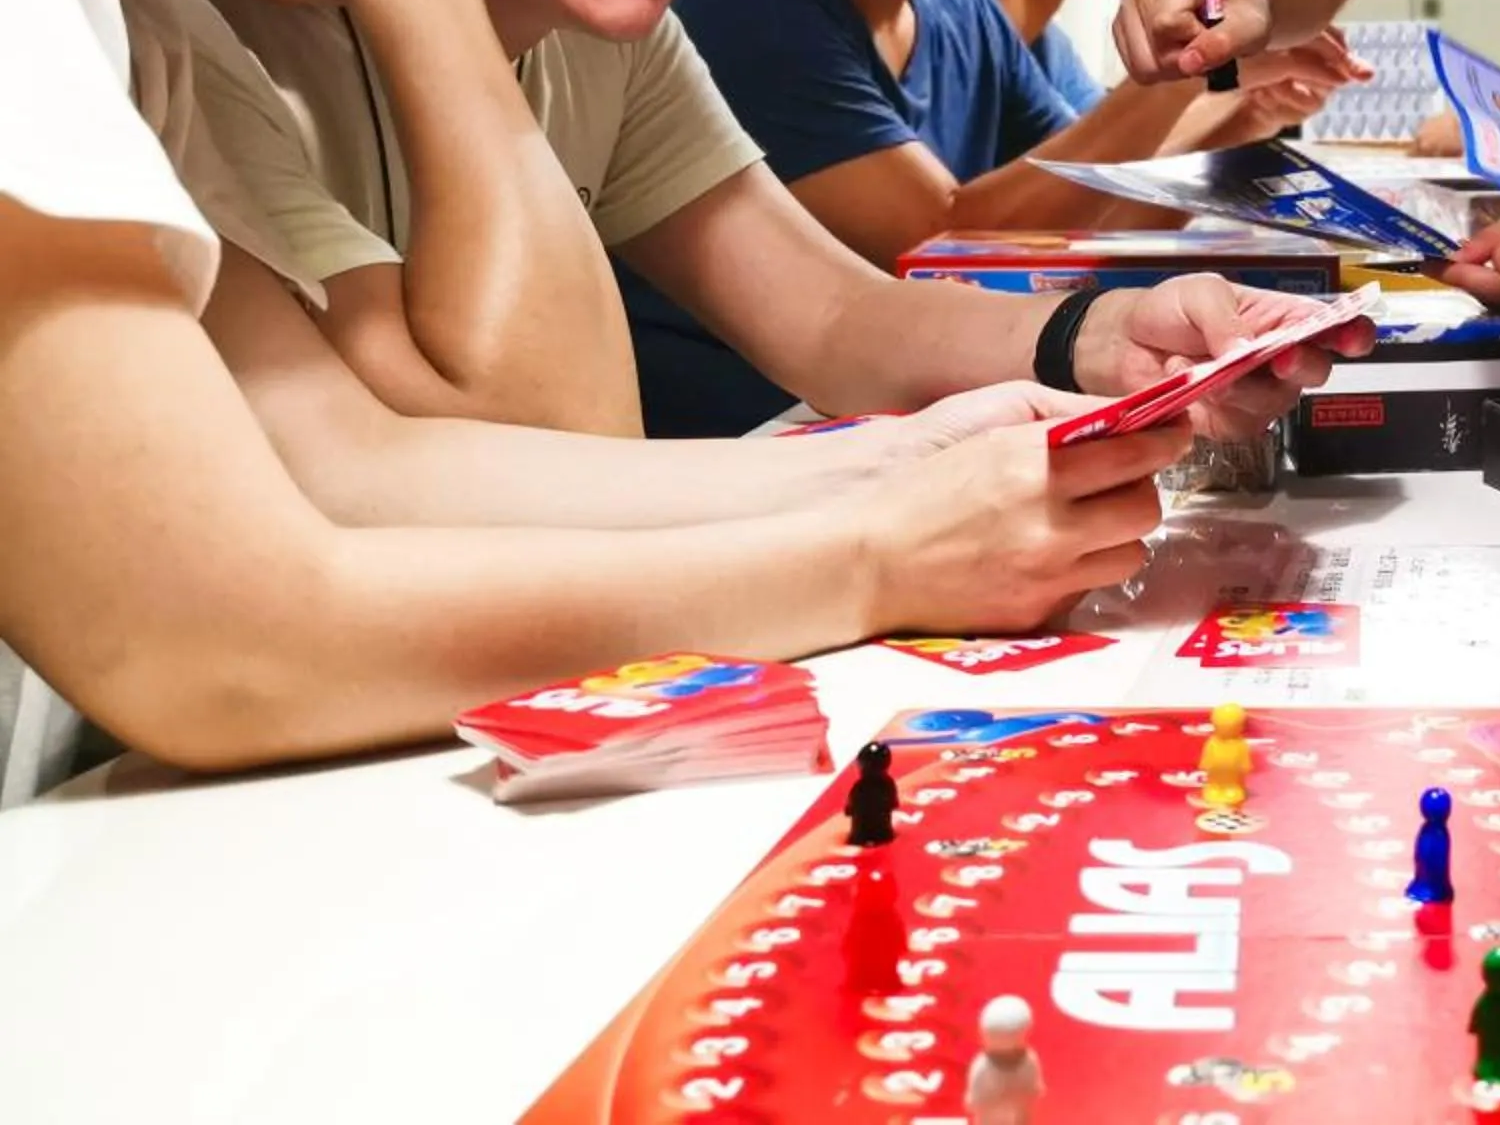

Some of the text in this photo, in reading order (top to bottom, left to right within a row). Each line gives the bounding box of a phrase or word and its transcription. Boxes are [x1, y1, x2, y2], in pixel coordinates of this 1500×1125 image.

[774, 893, 826, 913] 7
[928, 894, 978, 912] 7
[751, 926, 800, 947] 6
[909, 926, 960, 949] 6
[1051, 838, 1292, 1032] ALIAS
[725, 961, 777, 984] 5
[896, 959, 947, 985] 5
[711, 997, 764, 1018] 4
[884, 993, 937, 1014] 4
[691, 1036, 749, 1059] 3
[879, 1030, 936, 1053] 3
[681, 1076, 745, 1100] 2
[883, 1069, 945, 1094] 2
